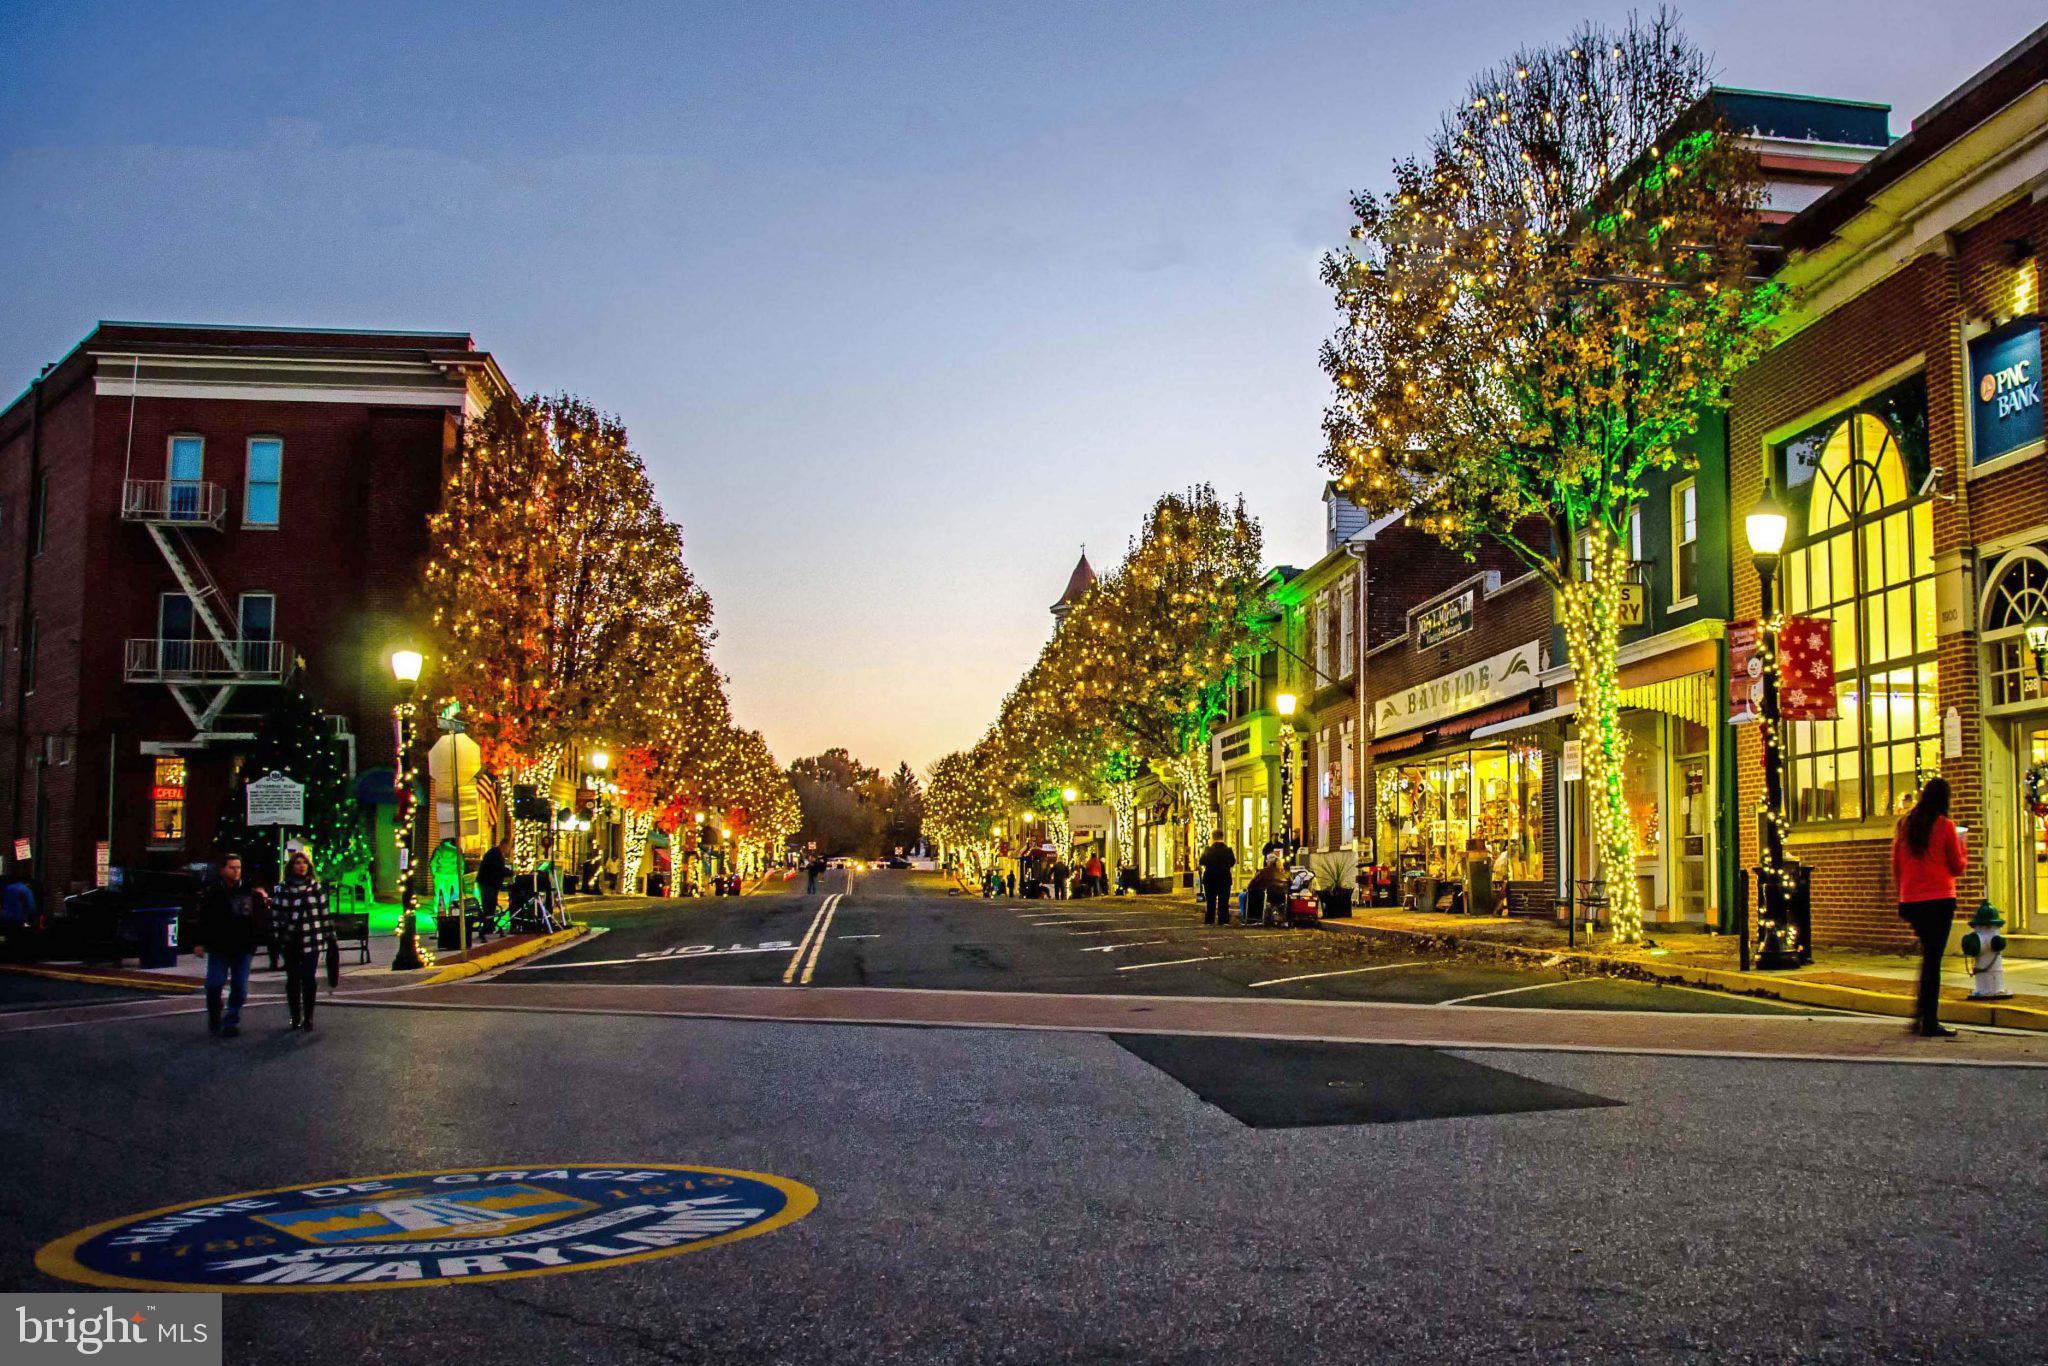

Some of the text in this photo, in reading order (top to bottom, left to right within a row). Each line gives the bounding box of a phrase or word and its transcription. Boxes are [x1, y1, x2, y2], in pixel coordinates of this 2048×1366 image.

[1995, 360, 2030, 394] PNC
[1997, 381, 2040, 418] BANK
[1408, 664, 1490, 715] BAYSIDE
[156, 788, 181, 798] OPEN
[108, 1170, 667, 1246] HAVRE DE GRACE
[239, 1207, 766, 1283] MARYLAND
[327, 1234, 537, 1256] DEFENSOR
